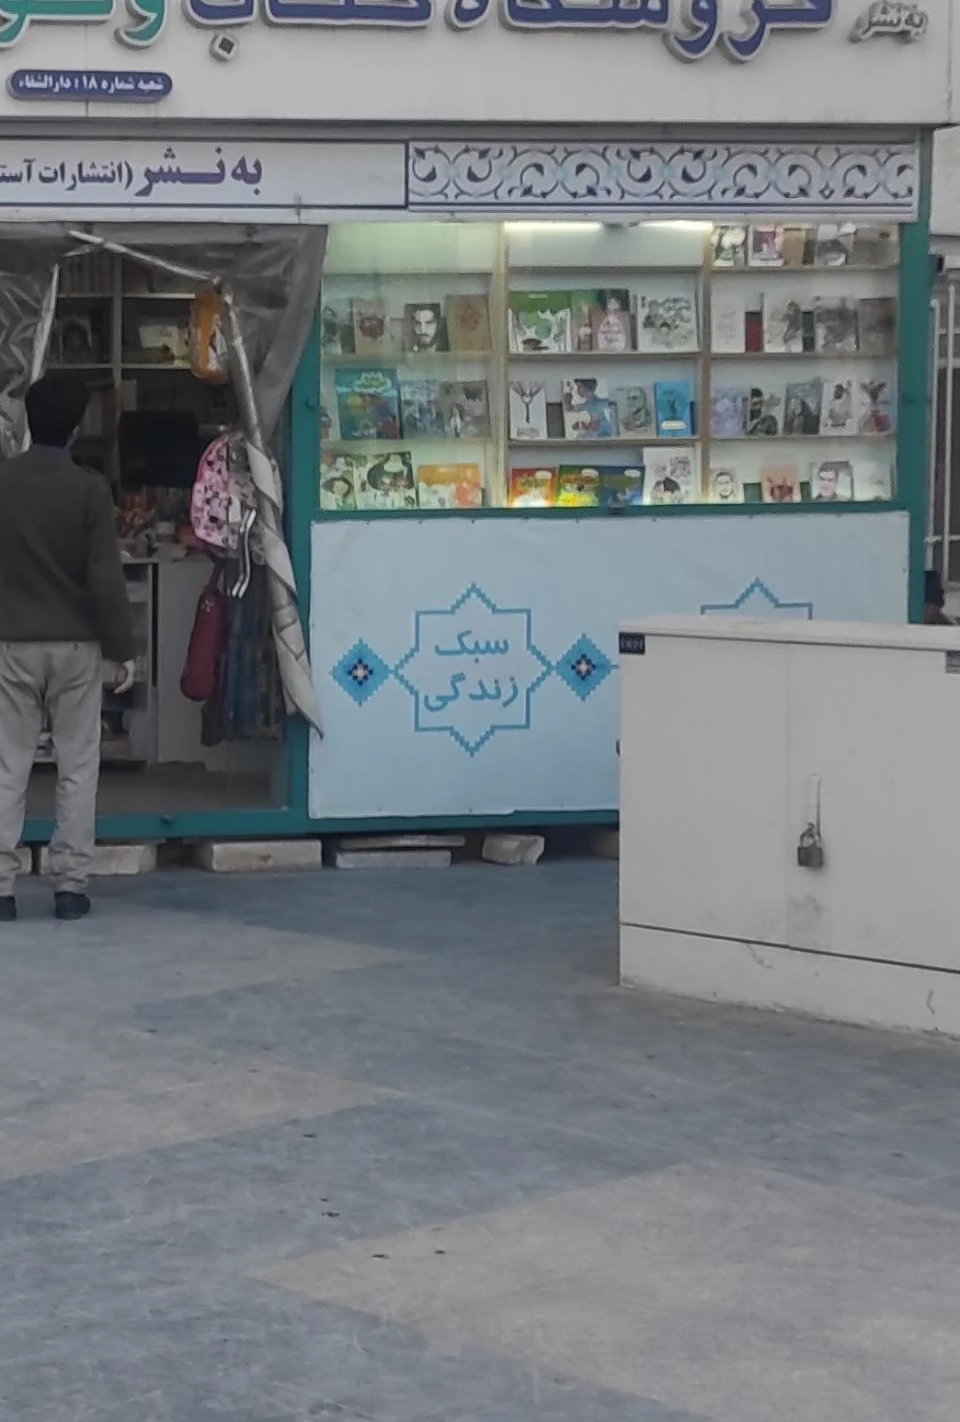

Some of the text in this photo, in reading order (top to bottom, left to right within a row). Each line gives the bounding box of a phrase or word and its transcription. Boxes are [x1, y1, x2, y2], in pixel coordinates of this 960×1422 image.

[100, 73, 137, 95] شماره
[38, 159, 134, 192] (انتشارات
[134, 146, 226, 197] نشر
[231, 154, 263, 196] به
[434, 630, 509, 664] سبک
[424, 674, 519, 711] زندگی
